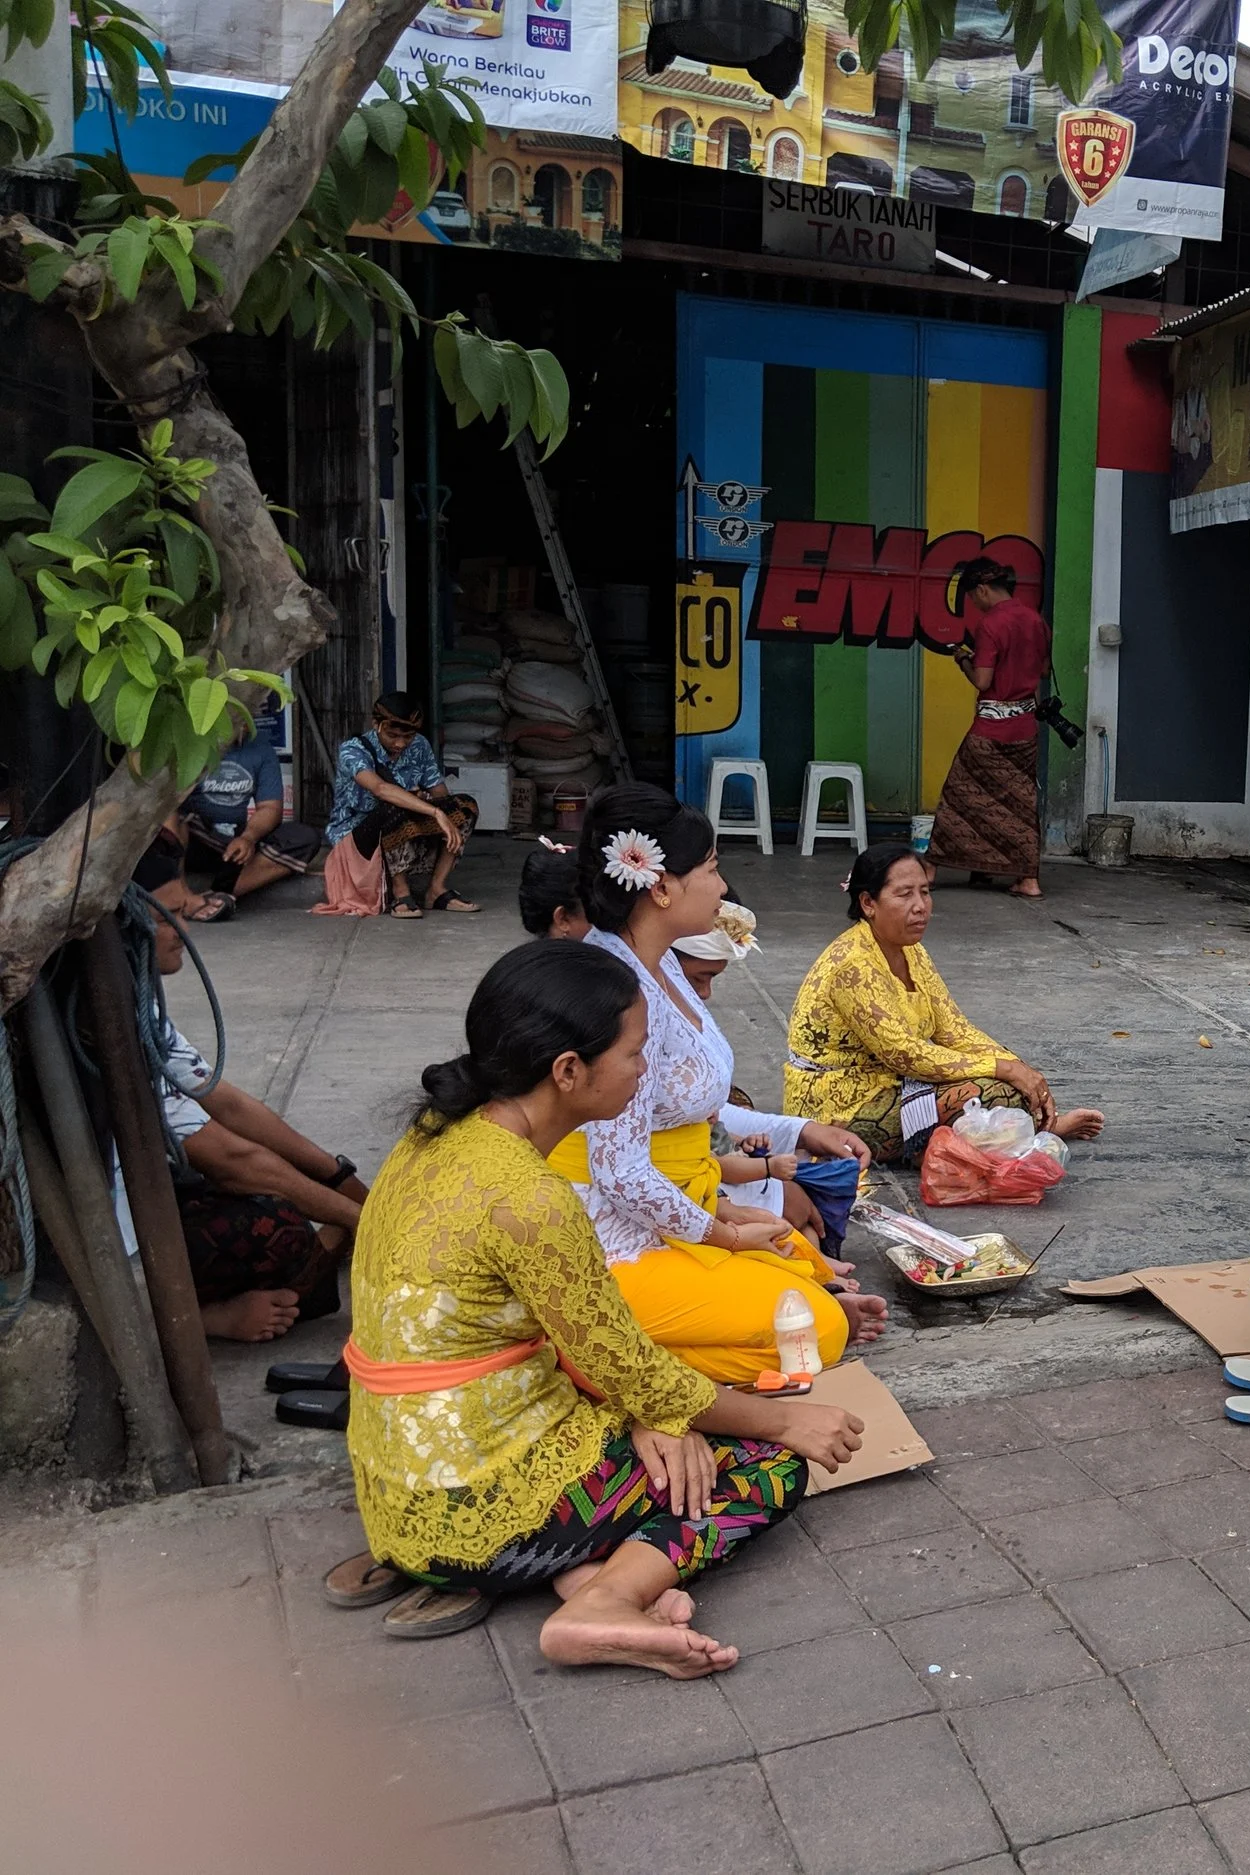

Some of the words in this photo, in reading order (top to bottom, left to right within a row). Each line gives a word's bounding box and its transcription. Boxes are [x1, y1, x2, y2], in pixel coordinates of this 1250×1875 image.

[531, 25, 566, 39] BRITE
[531, 35, 567, 47] GLOW
[409, 46, 469, 69] Warna
[475, 56, 546, 80] Berkilau
[1139, 80, 1203, 101] ACRYLIC
[114, 97, 187, 122] OKO
[194, 102, 227, 126] INI
[1070, 122, 1122, 143] GARANSI
[1083, 139, 1105, 177] 6
[768, 178, 861, 222] SERBUK
[869, 194, 934, 233] TANAH
[808, 220, 895, 262] TARO
